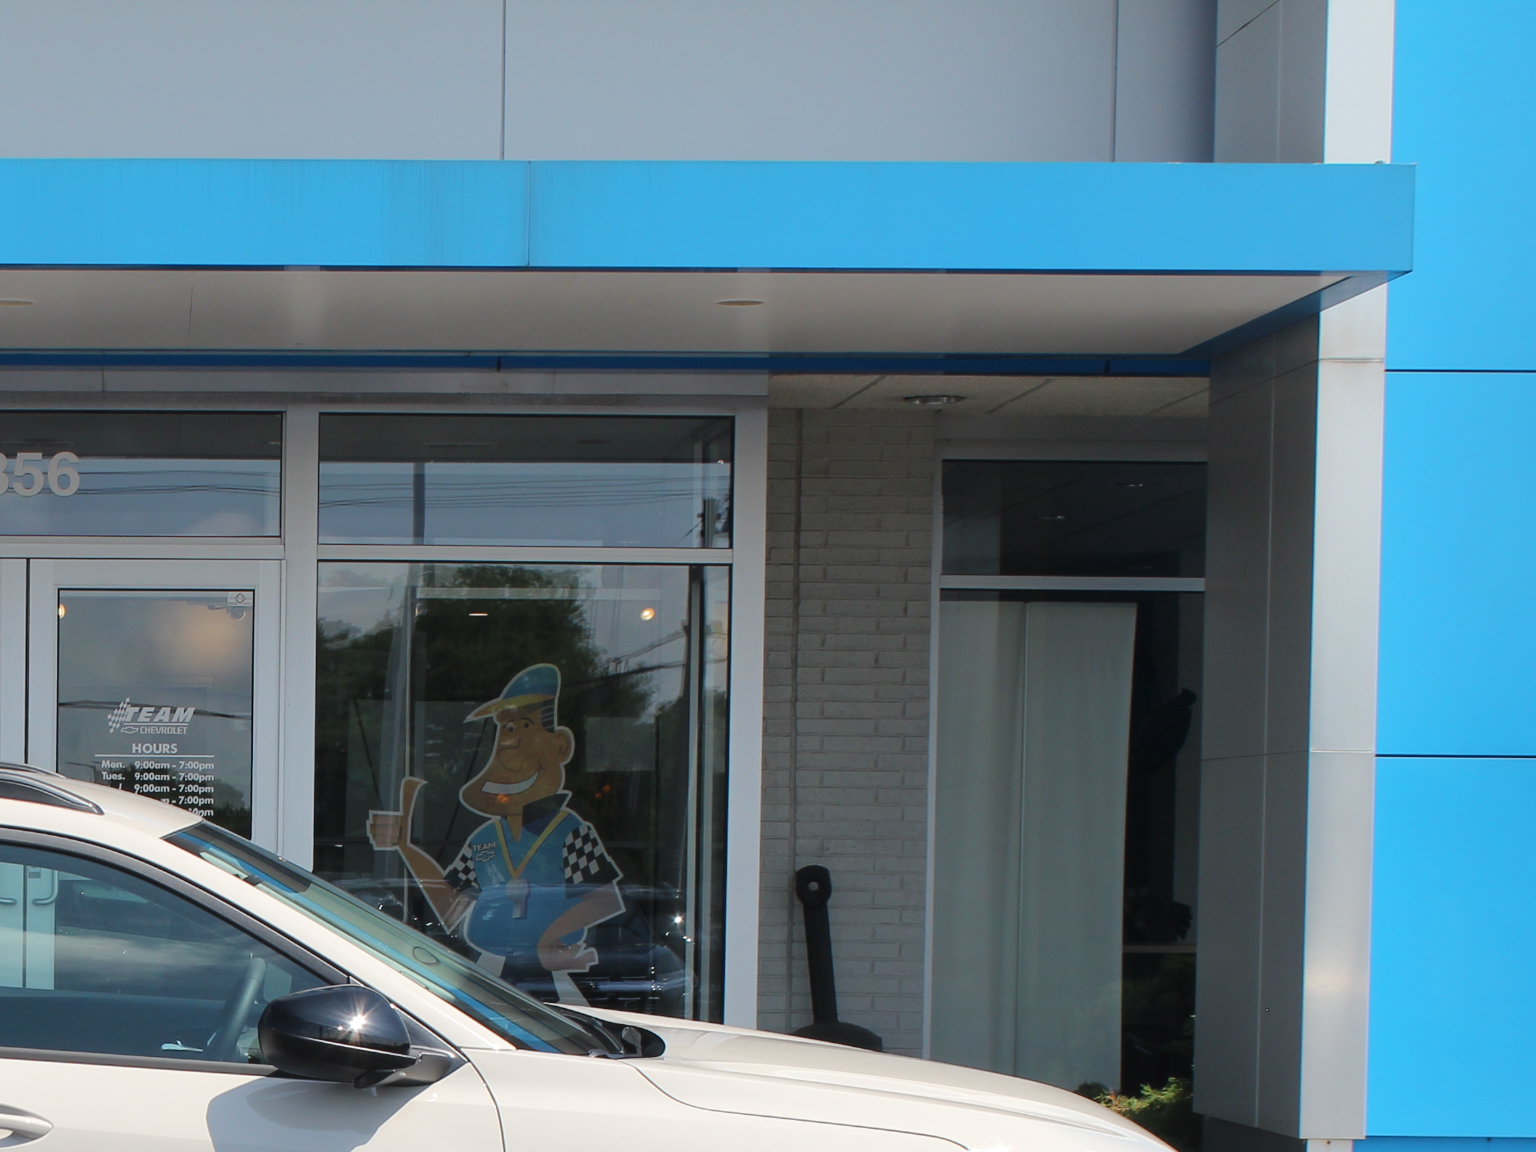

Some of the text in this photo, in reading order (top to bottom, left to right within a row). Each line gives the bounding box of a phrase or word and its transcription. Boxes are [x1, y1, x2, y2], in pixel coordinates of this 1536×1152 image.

[125, 706, 196, 722] TEAM
[140, 726, 188, 735] CHEVROLET
[132, 743, 178, 754] HOURS
[101, 760, 126, 769] Mon.
[134, 761, 170, 770] 9:00am
[178, 761, 215, 772] 7:00pm
[101, 771, 126, 781] Tues.
[134, 772, 170, 781] 9:00am
[178, 772, 215, 783] 7:00pm
[133, 783, 170, 794] 9:00am
[178, 784, 215, 795] 7:00pm
[178, 796, 215, 807] 7:00pm
[472, 842, 497, 851] TEAM
